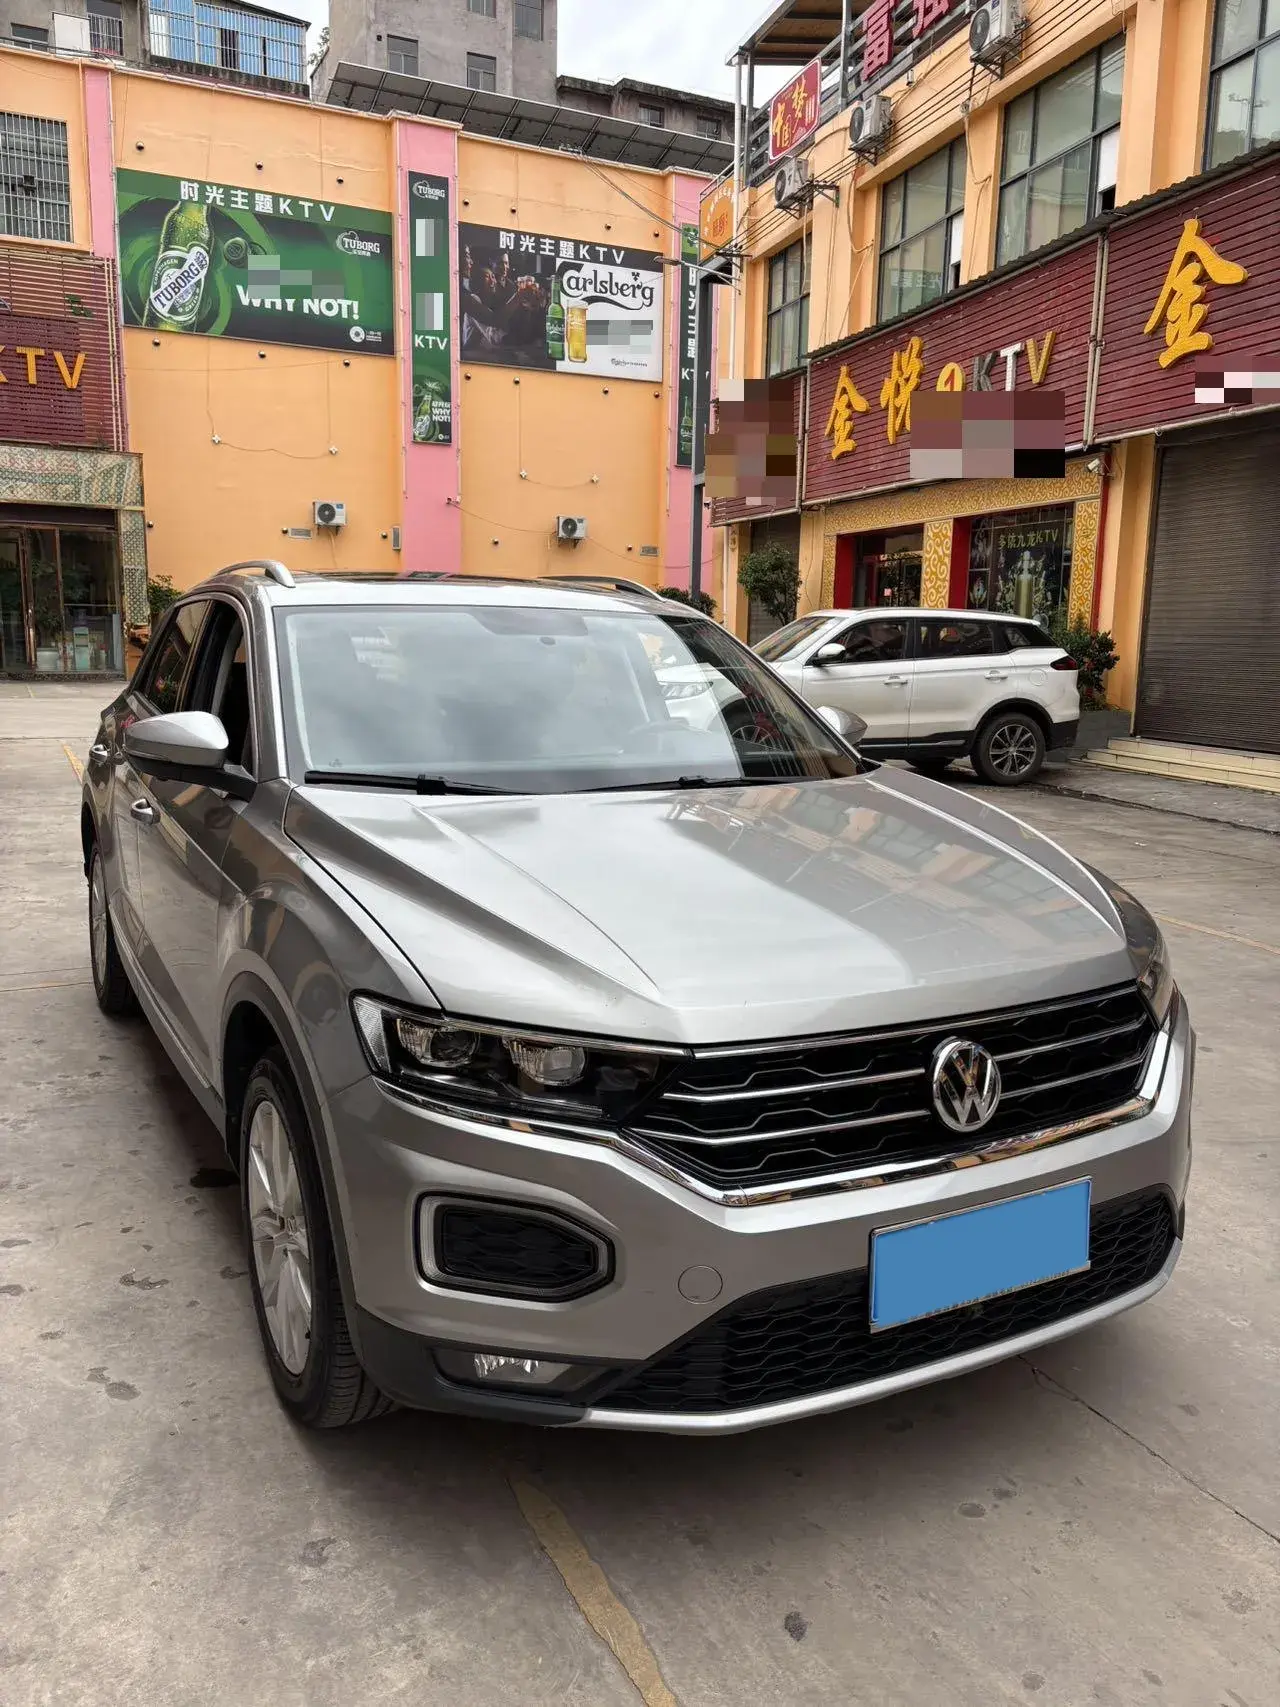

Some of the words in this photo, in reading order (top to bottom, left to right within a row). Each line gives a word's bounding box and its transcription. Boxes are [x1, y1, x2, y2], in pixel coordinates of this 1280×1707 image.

[180, 181, 335, 222] 时光主题KTV
[417, 185, 445, 198] TUBORG
[343, 238, 380, 253] TUBORG
[500, 231, 625, 264] 时光主题KTV
[154, 262, 201, 309] TUBORG
[556, 260, 655, 310] Carlsberg
[1143, 218, 1249, 369] 金
[303, 298, 359, 320] NOT!
[414, 334, 448, 350] KTV
[972, 331, 1056, 391] KTV
